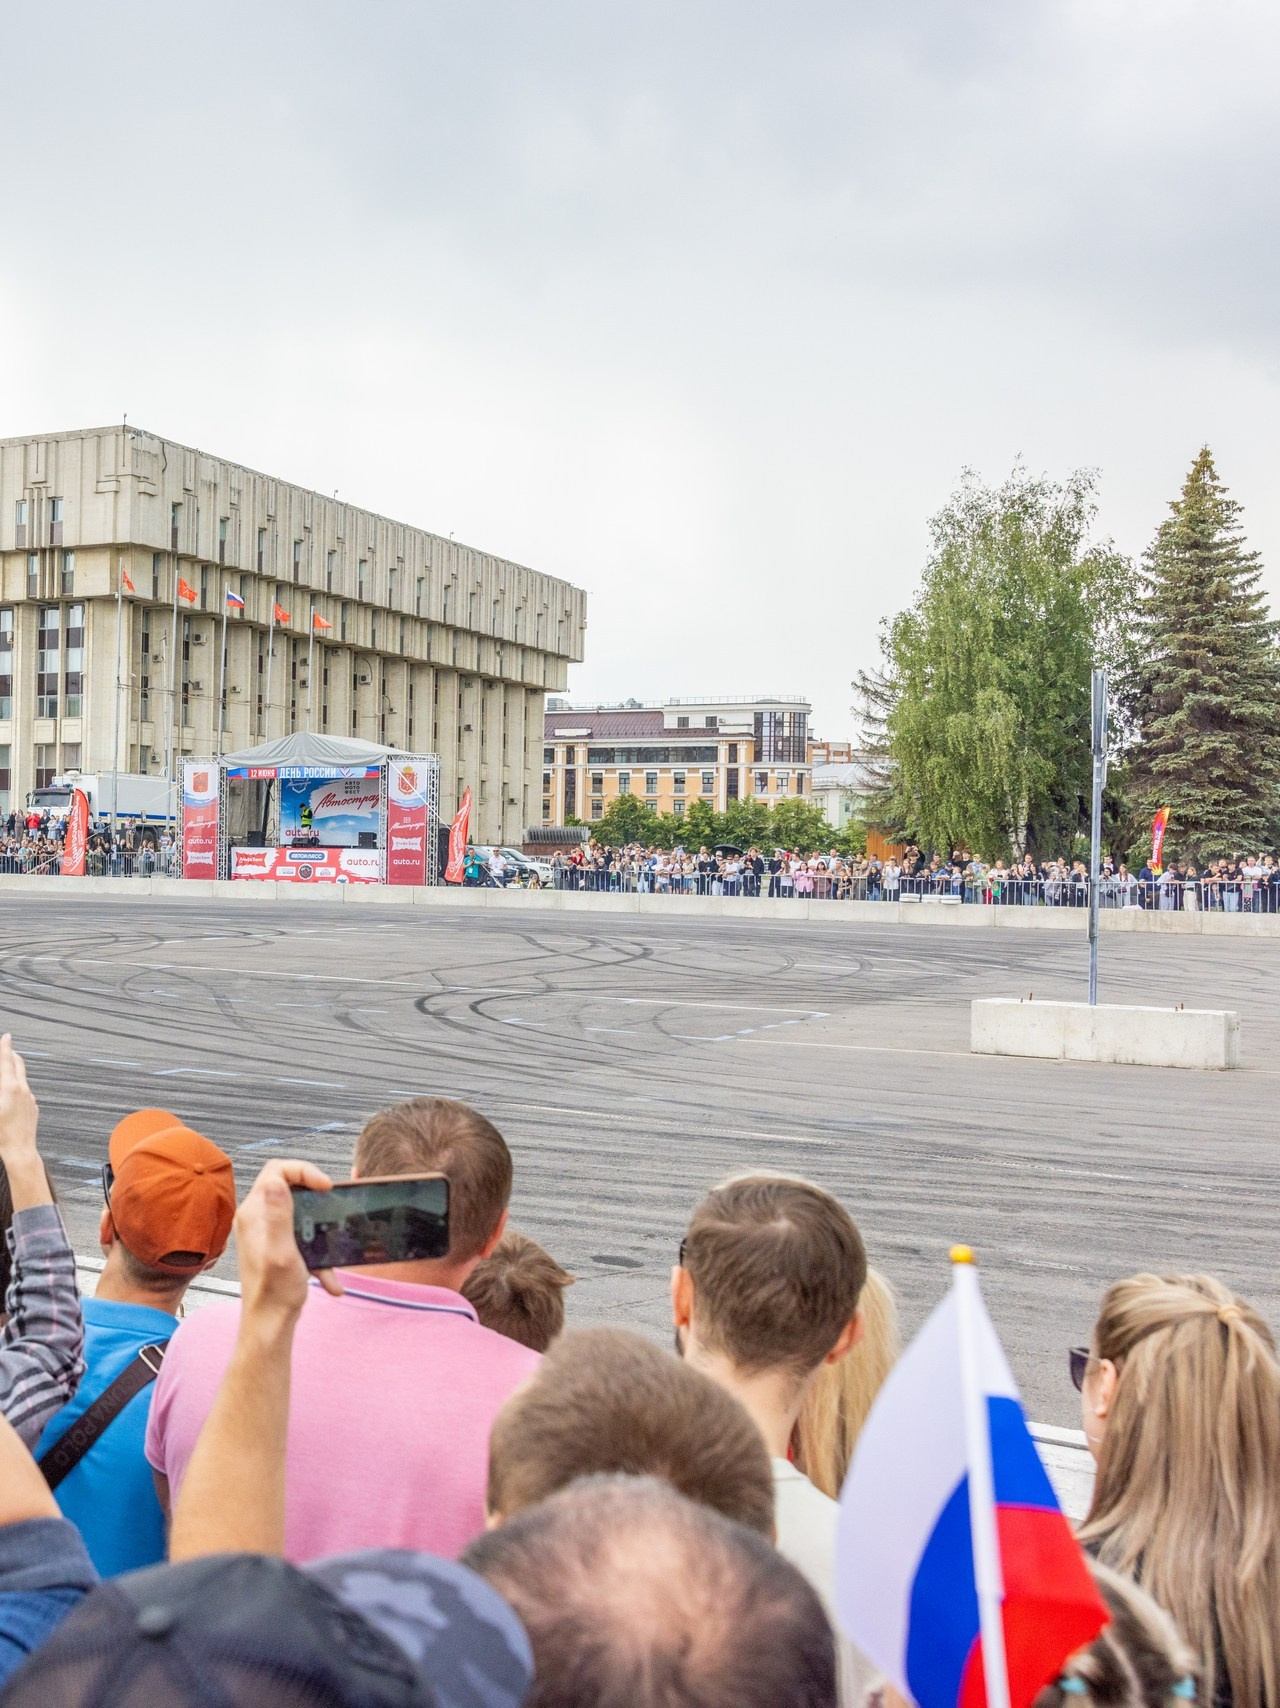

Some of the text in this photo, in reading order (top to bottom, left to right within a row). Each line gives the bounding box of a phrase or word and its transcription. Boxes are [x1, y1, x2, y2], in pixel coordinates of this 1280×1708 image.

[250, 767, 337, 779] 12 ИЮНЯ ДЕНЬ РОССИИ
[313, 792, 380, 814] Автострад
[285, 828, 320, 838] autru
[347, 858, 380, 866] auto.ru
